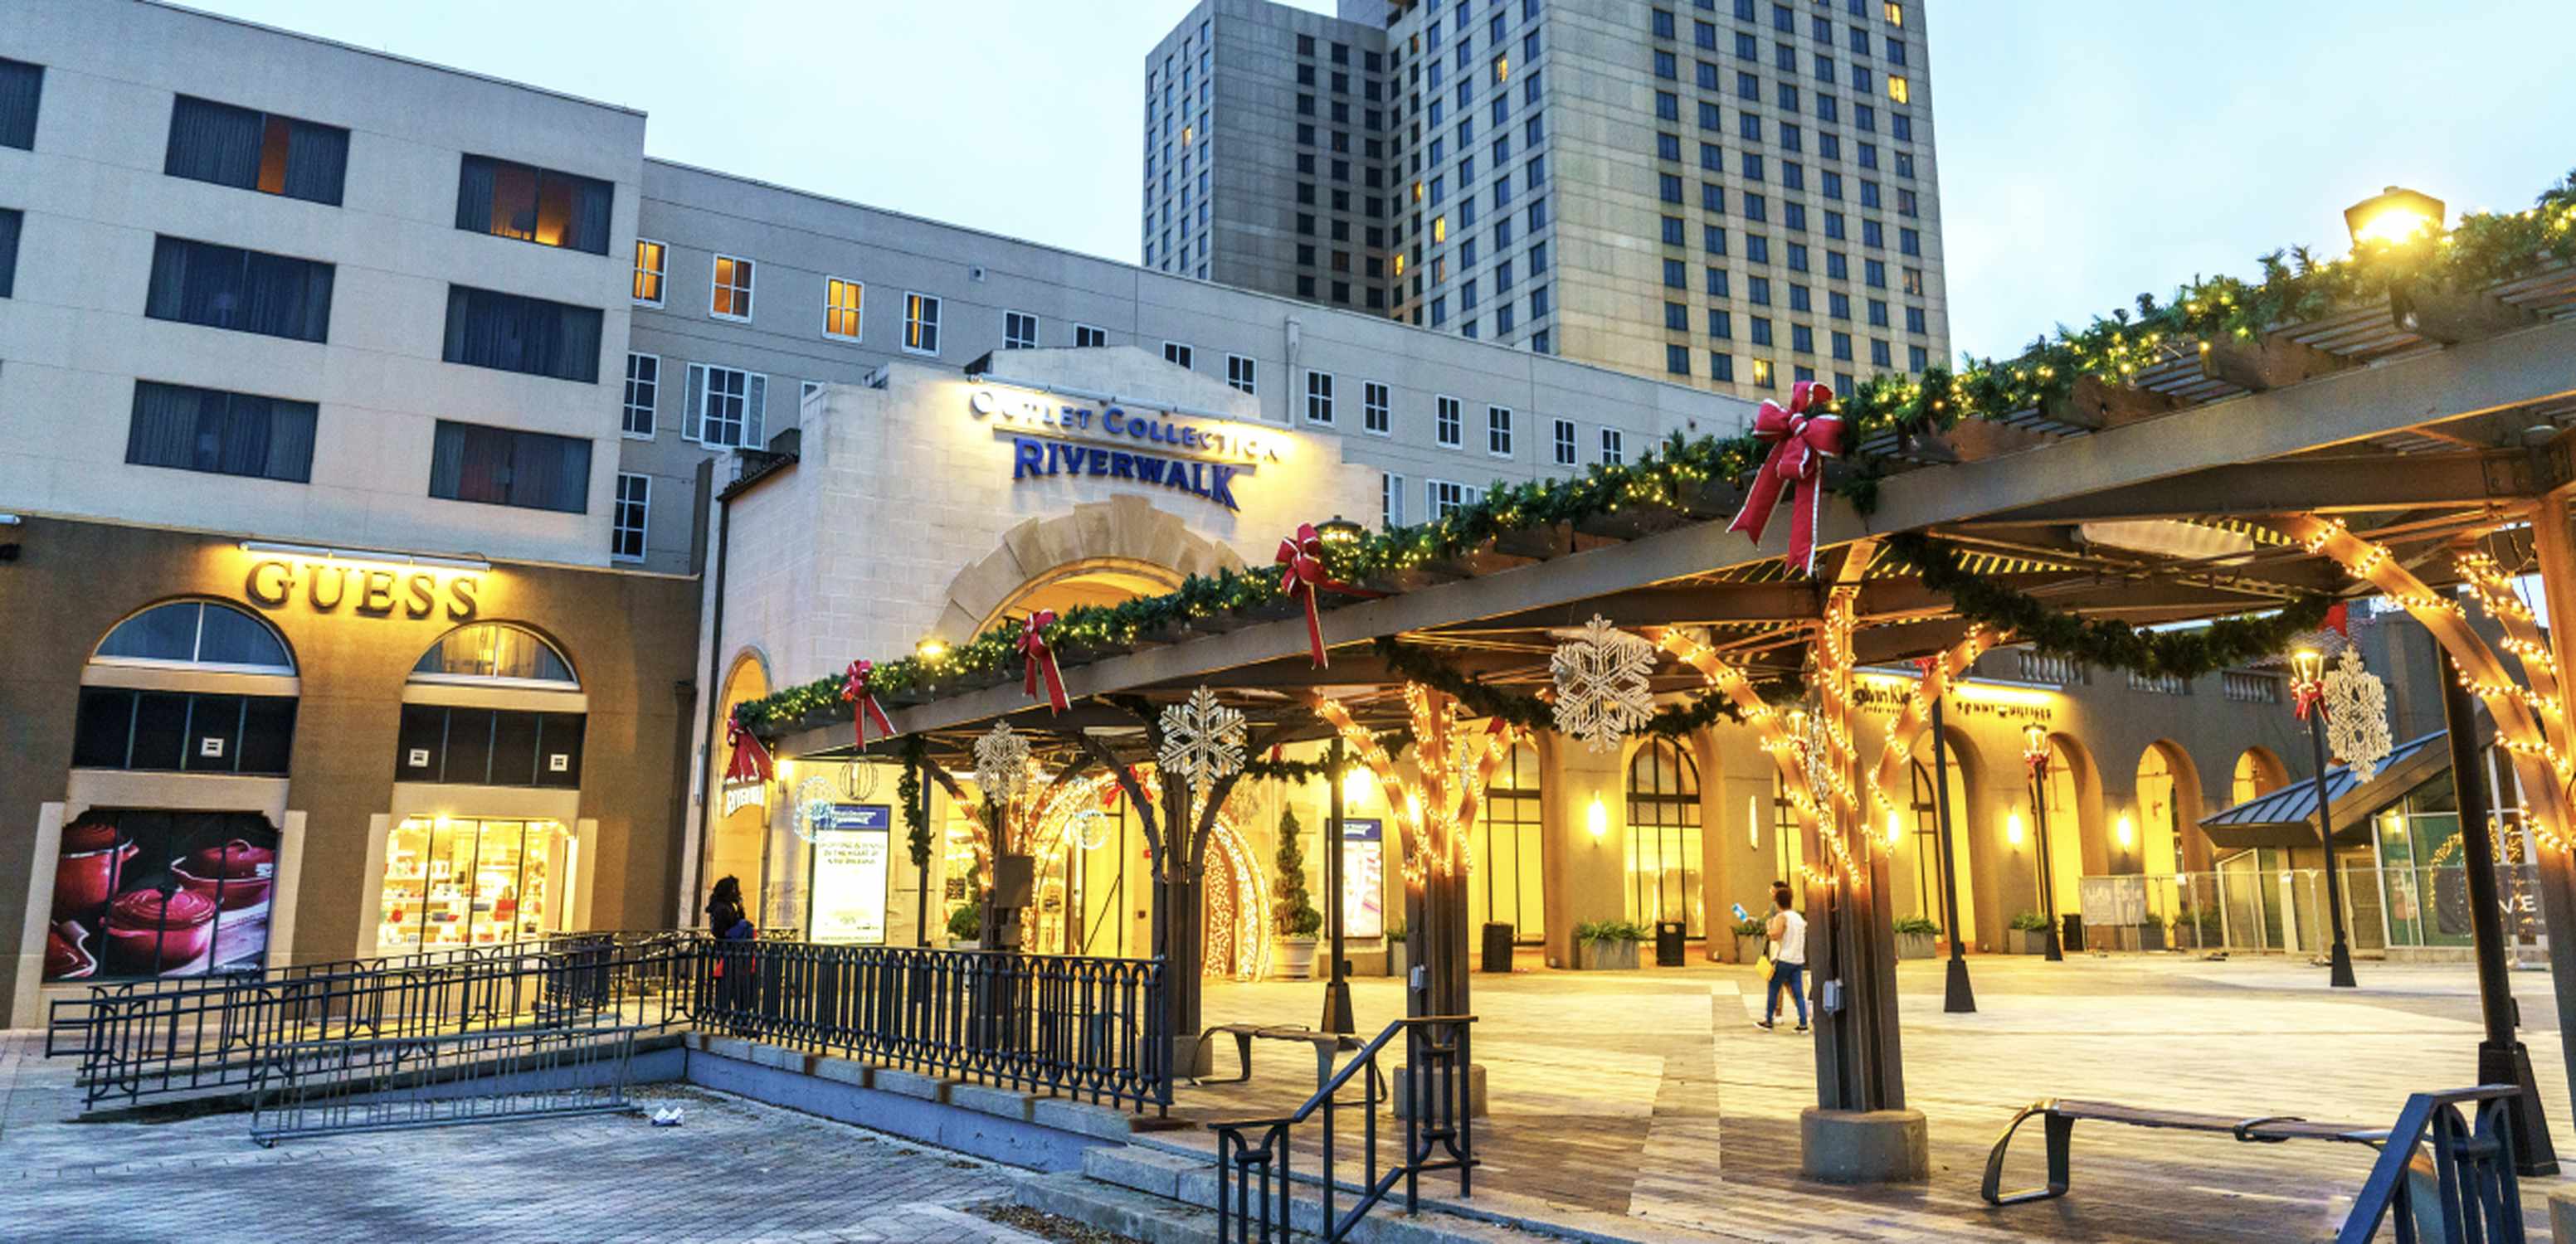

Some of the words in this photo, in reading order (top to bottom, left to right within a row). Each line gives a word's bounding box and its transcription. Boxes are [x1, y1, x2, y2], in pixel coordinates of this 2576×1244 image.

[1103, 406, 1280, 464] COLLECTION
[1012, 436, 1241, 513] RIVERWALK
[244, 559, 479, 622] GUESS
